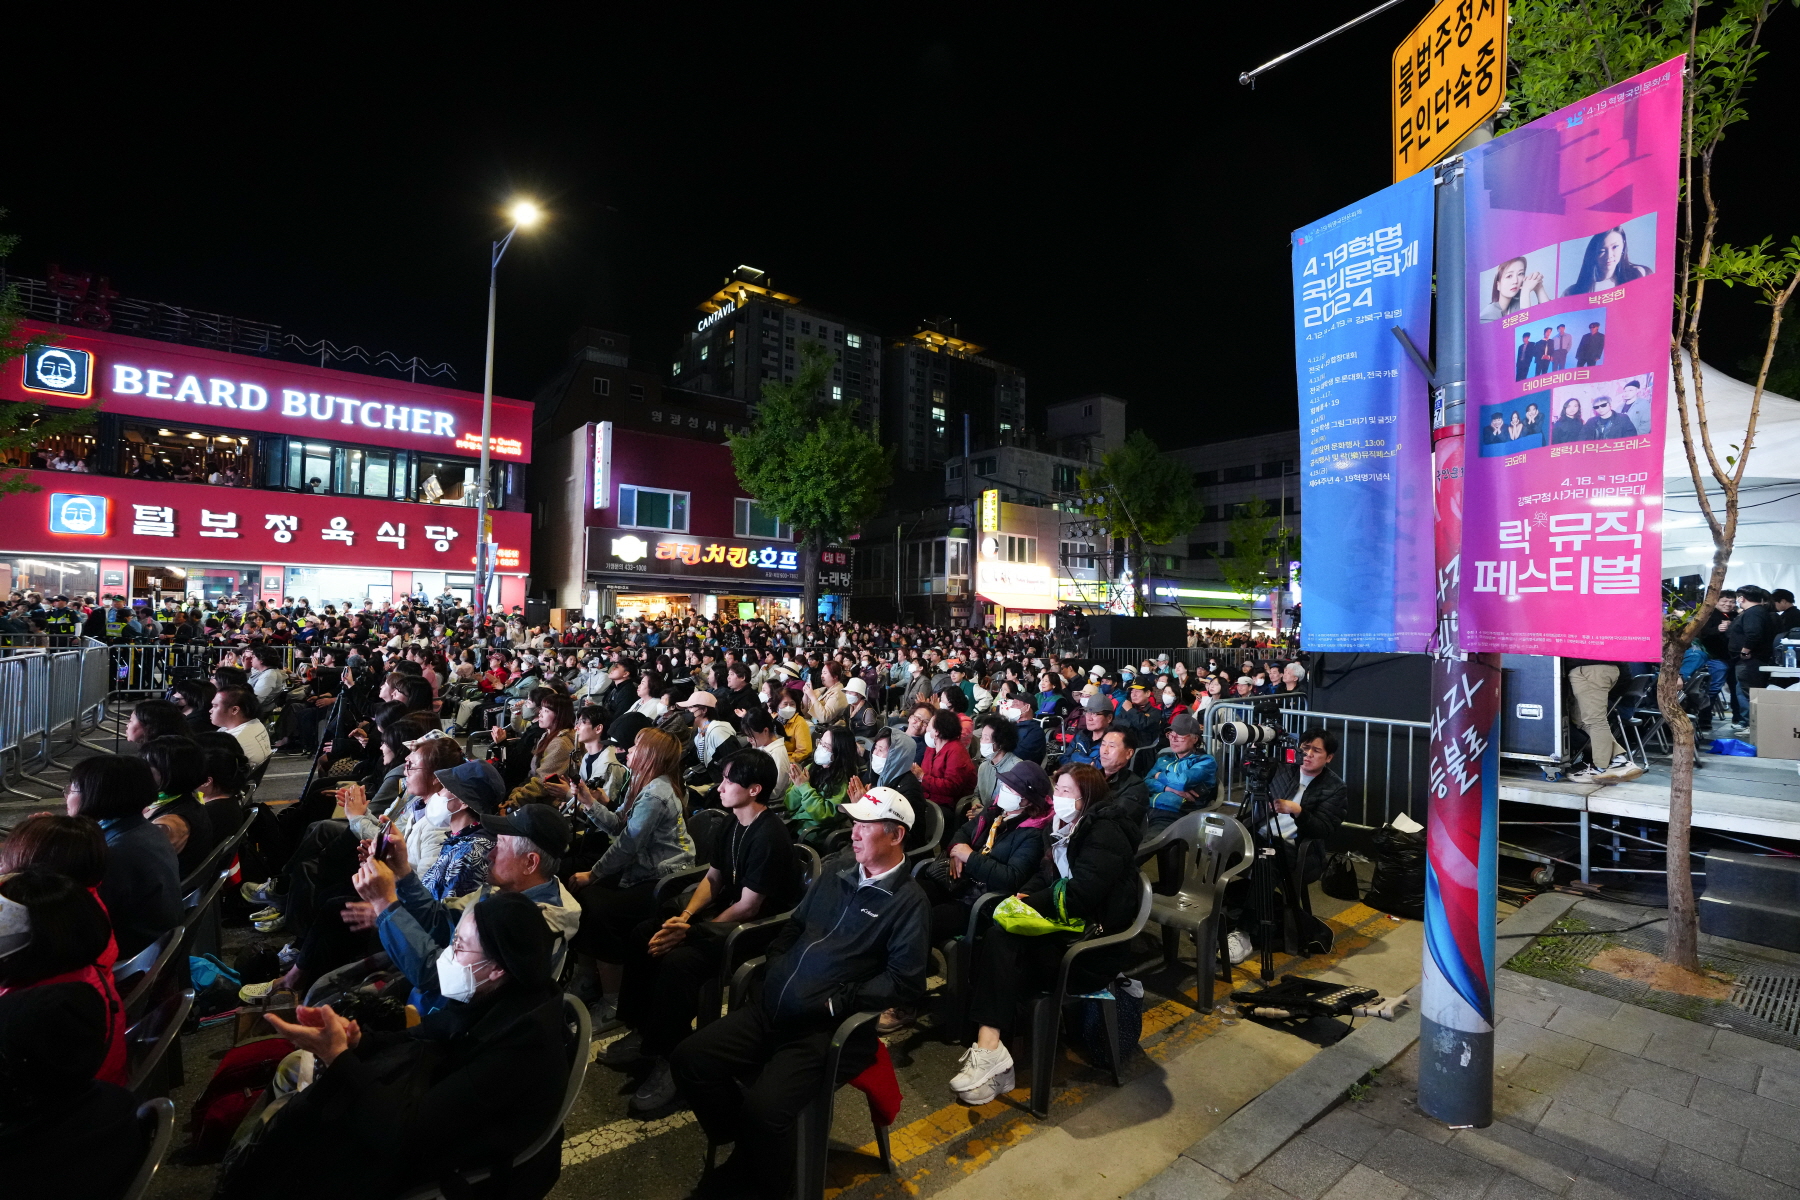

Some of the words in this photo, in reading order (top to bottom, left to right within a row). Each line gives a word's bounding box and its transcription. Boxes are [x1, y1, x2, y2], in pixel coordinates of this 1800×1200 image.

[1399, 37, 1496, 164] 무인단속중
[1303, 240, 1418, 301] 국민문화제
[1303, 287, 1373, 328] 2024
[1589, 288, 1626, 305] 박정현
[697, 302, 736, 332] CANTAVIL
[1355, 311, 1383, 325] 강북구
[1502, 312, 1530, 329] 장윤정
[1367, 370, 1382, 380] 전국
[1523, 370, 1590, 392] 데이브레이크
[112, 364, 268, 412] BEARD
[282, 388, 456, 438] BUTCHER
[1331, 417, 1368, 429] 그림그리기
[1369, 416, 1376, 425] 및
[1550, 437, 1651, 458] 갤럭시익스프레스
[1504, 453, 1527, 468] 코요태
[1609, 472, 1648, 484] 19:00
[1518, 492, 1551, 507] 강북구청
[1552, 488, 1591, 500] 사거리
[1591, 484, 1646, 499] 메인무대
[133, 503, 459, 552] 털보정육식당
[1499, 518, 1532, 555] 락
[1549, 509, 1645, 553] 뮤직
[818, 571, 852, 587] 노래방
[1473, 554, 1642, 596] 페스티벌
[1430, 725, 1488, 799] 등불로
